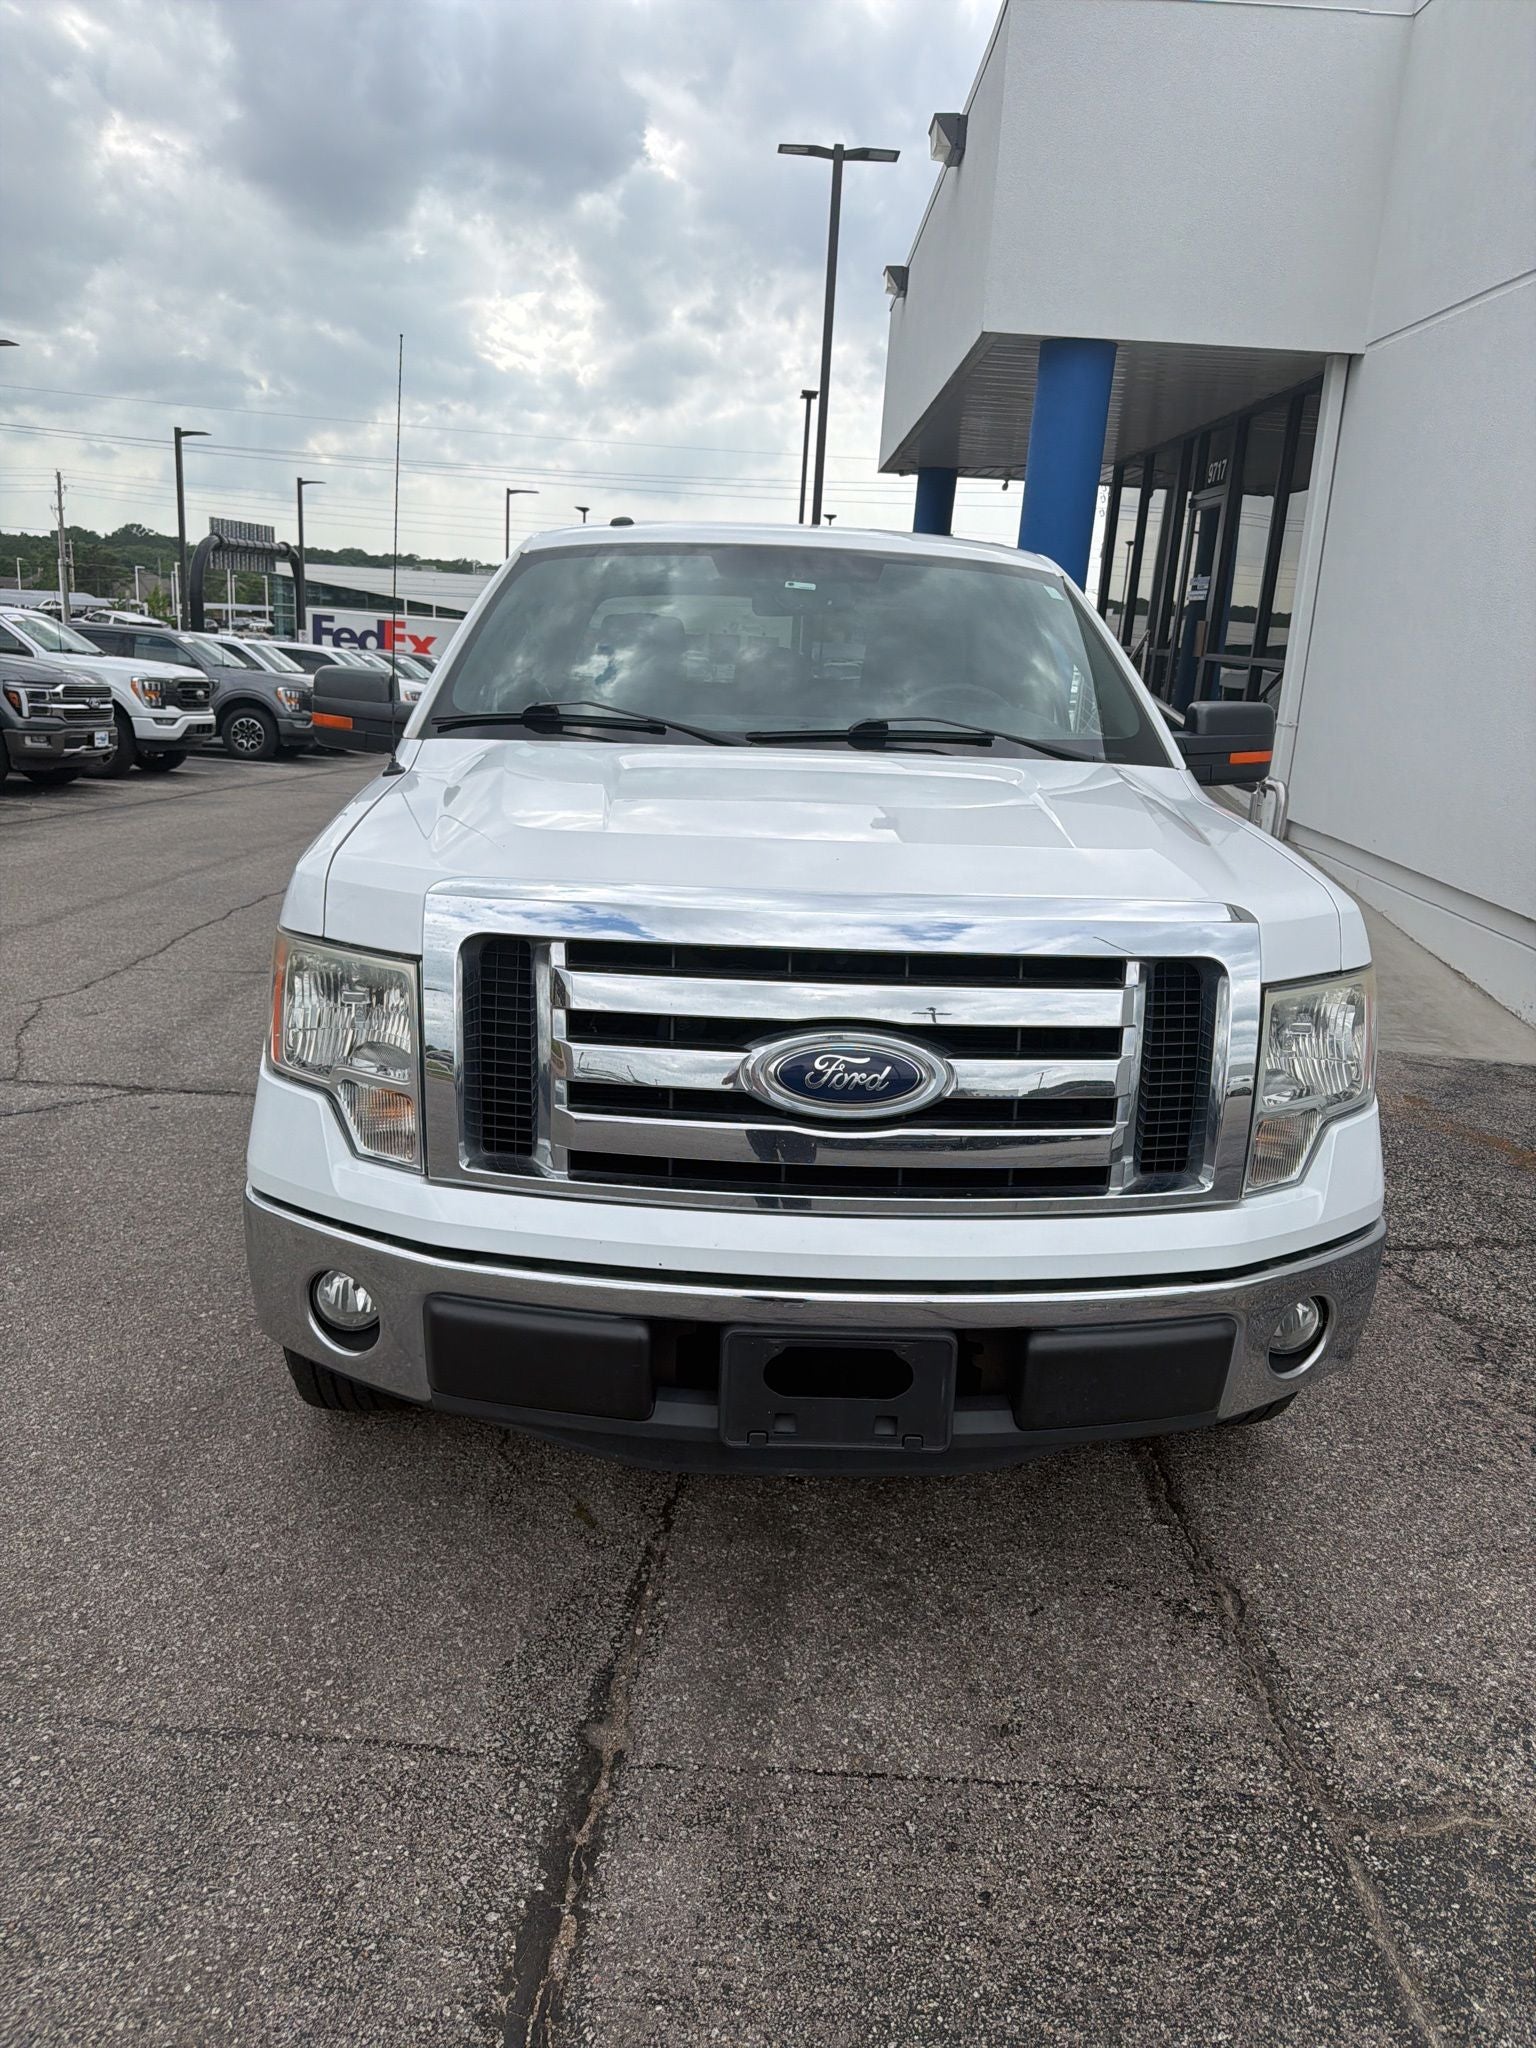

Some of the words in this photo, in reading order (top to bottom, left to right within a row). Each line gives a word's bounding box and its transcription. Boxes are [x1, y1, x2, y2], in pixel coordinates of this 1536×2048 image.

[1207, 459, 1228, 484] 9717
[312, 613, 437, 655] FedEx
[804, 1054, 892, 1092] Ford
